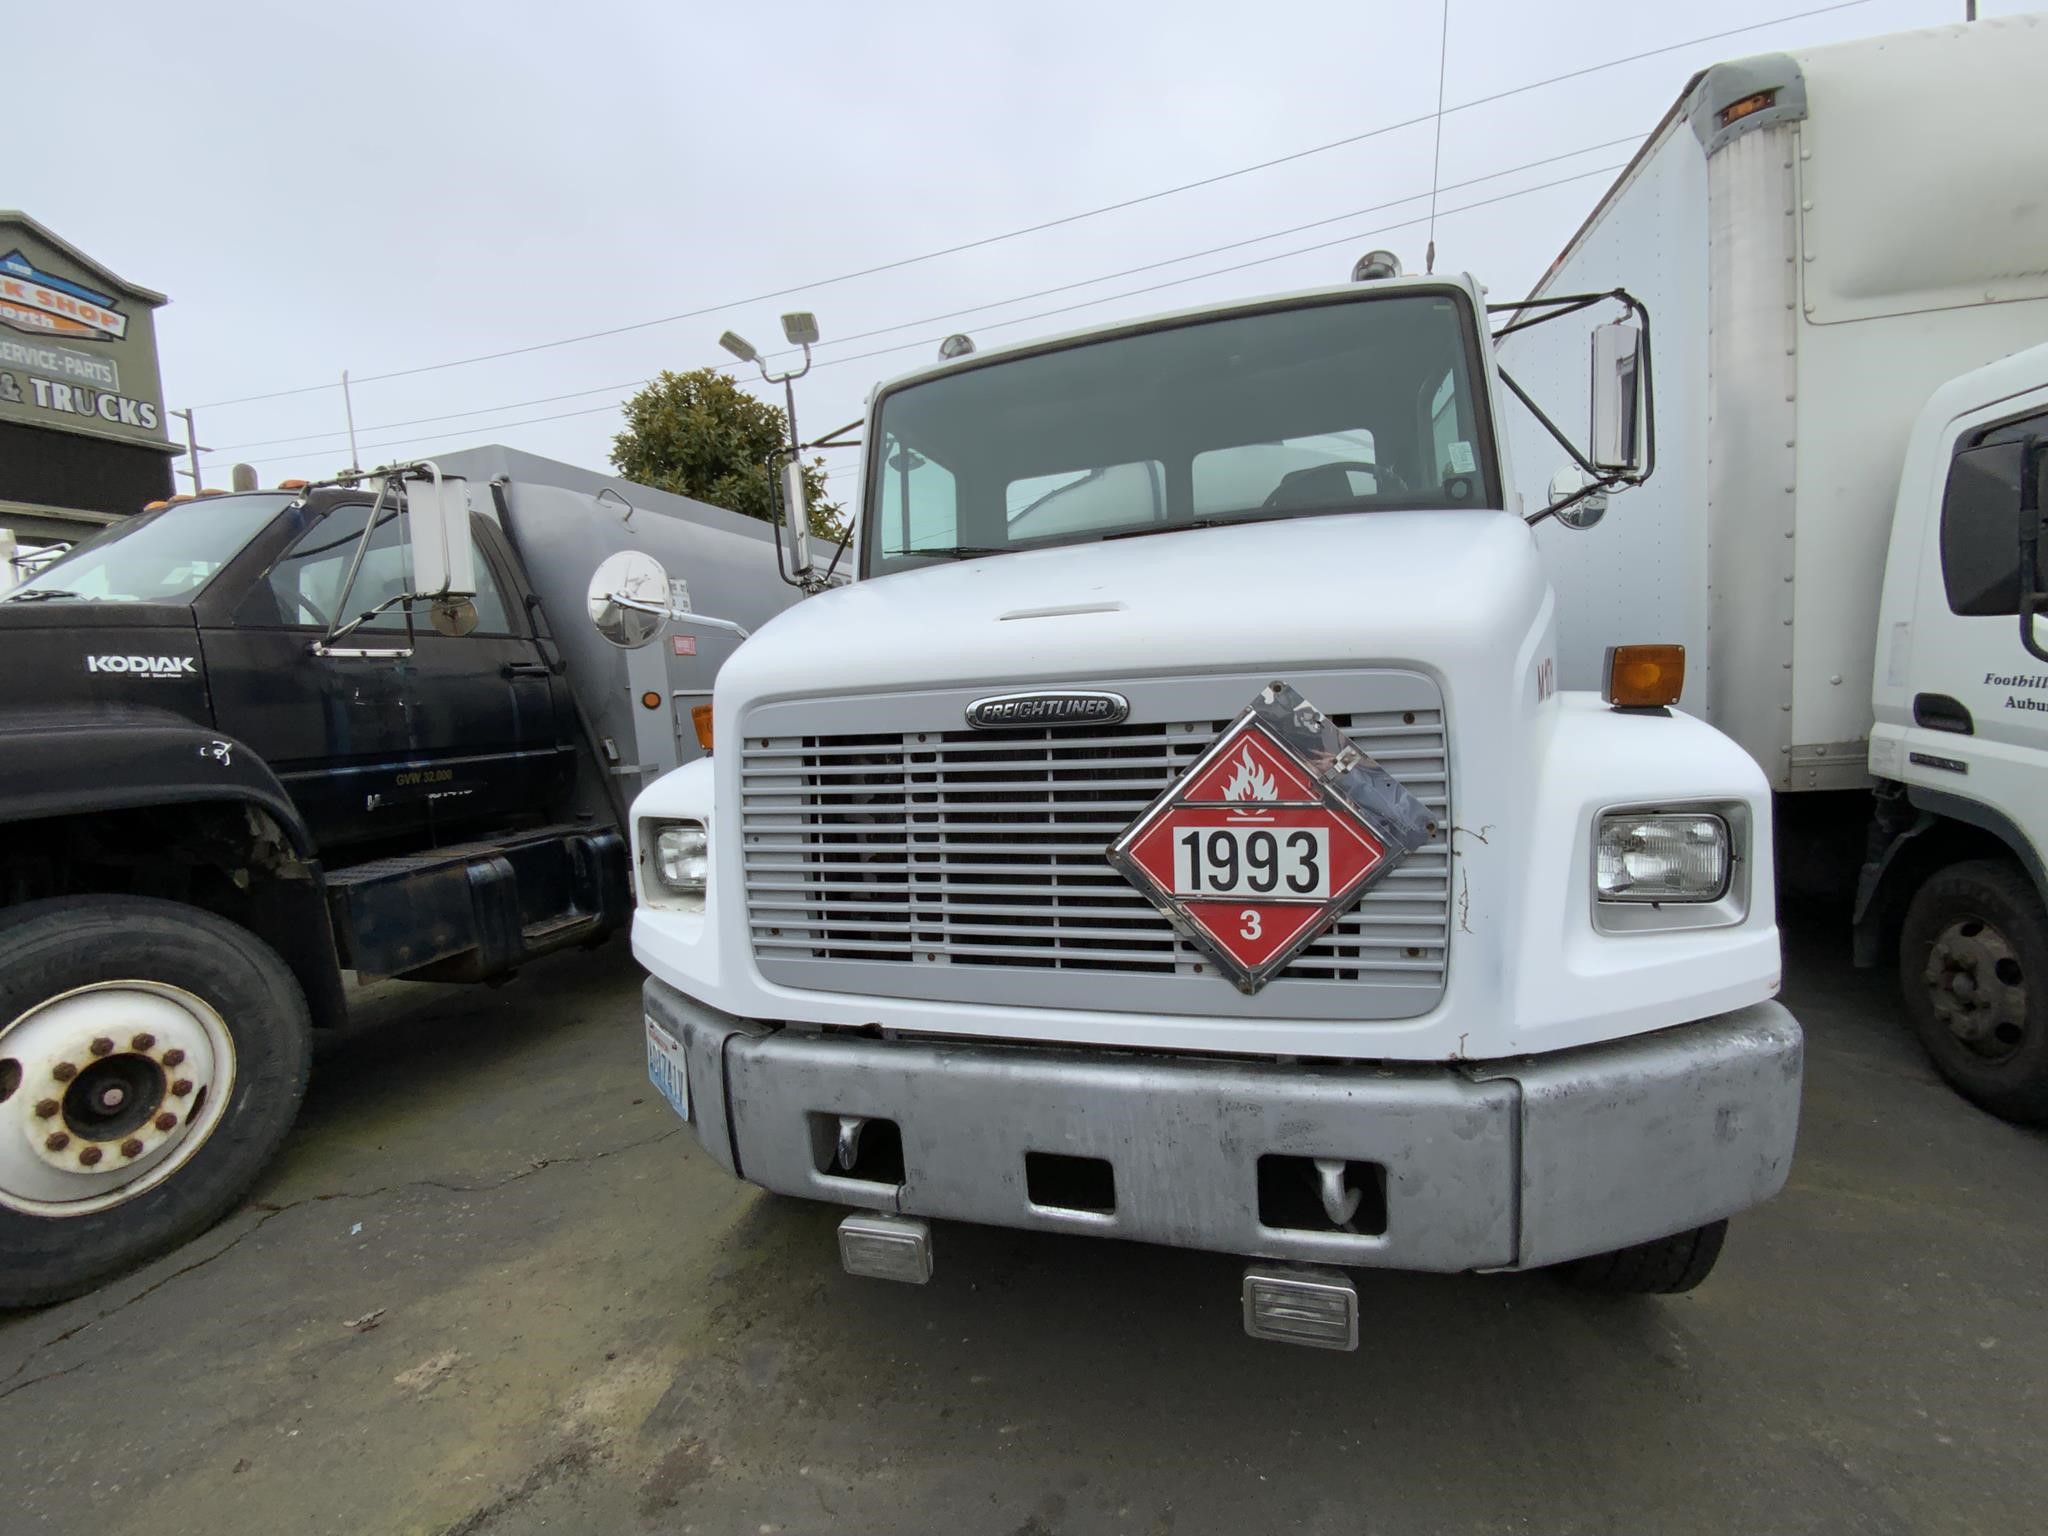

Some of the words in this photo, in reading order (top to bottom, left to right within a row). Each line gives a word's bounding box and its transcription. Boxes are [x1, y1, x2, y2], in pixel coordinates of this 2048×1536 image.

[0, 306, 54, 330] orth
[36, 289, 120, 327] SHOP
[0, 372, 23, 403] &
[29, 376, 159, 430] TRUCKS
[87, 655, 198, 673] KODIAK
[1984, 672, 2048, 689] Foothill
[982, 699, 1109, 721] FREIGHTLINER
[2004, 695, 2048, 713] Aubu
[1181, 830, 1320, 893] 1993
[1239, 909, 1263, 940] 3
